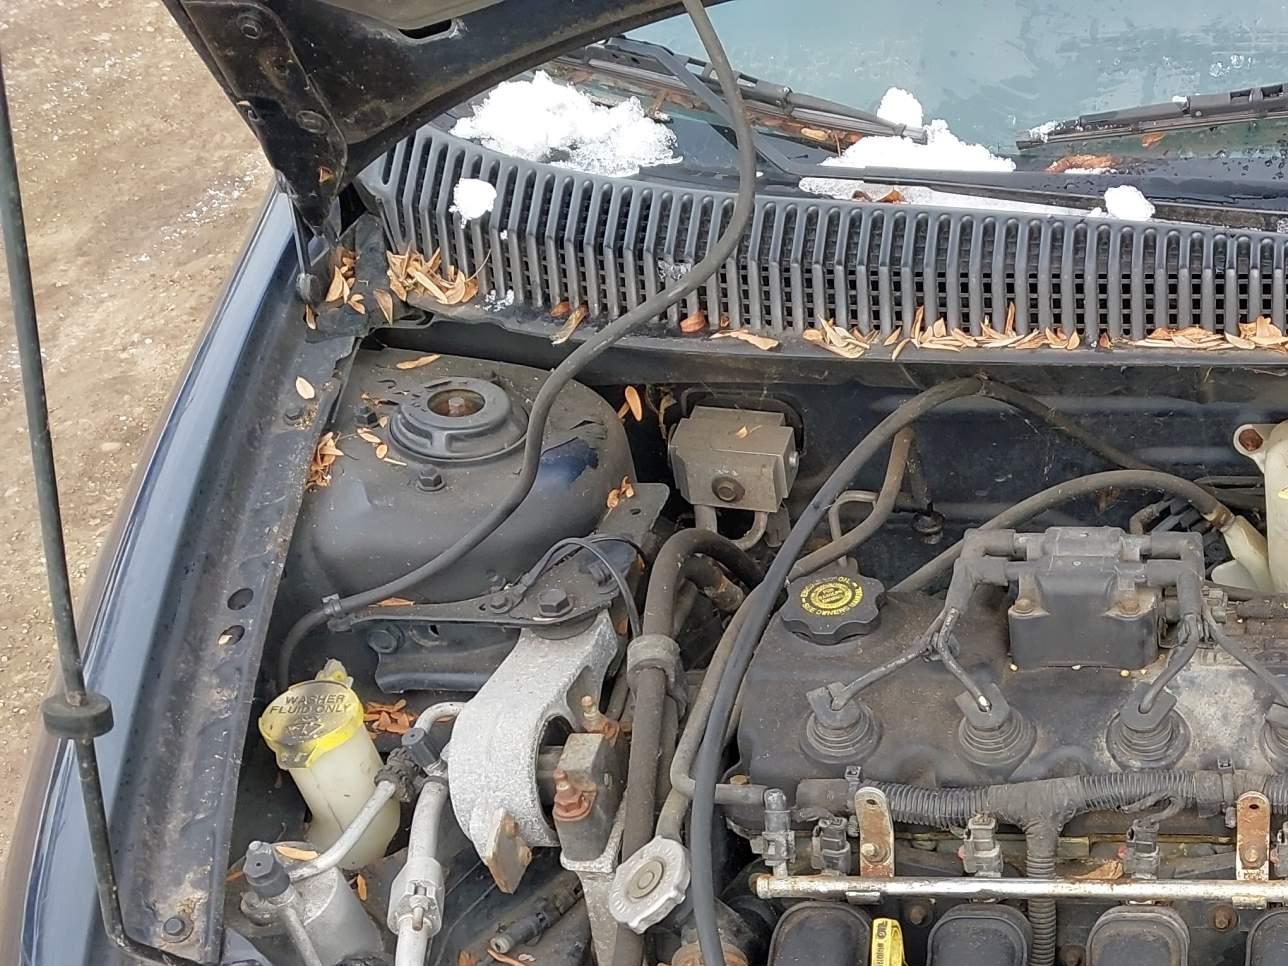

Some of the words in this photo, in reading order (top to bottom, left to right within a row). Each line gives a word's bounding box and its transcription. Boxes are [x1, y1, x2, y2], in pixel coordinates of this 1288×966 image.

[285, 694, 345, 705] WASHER
[269, 705, 310, 714] FLUID
[315, 703, 352, 713] ONLY
